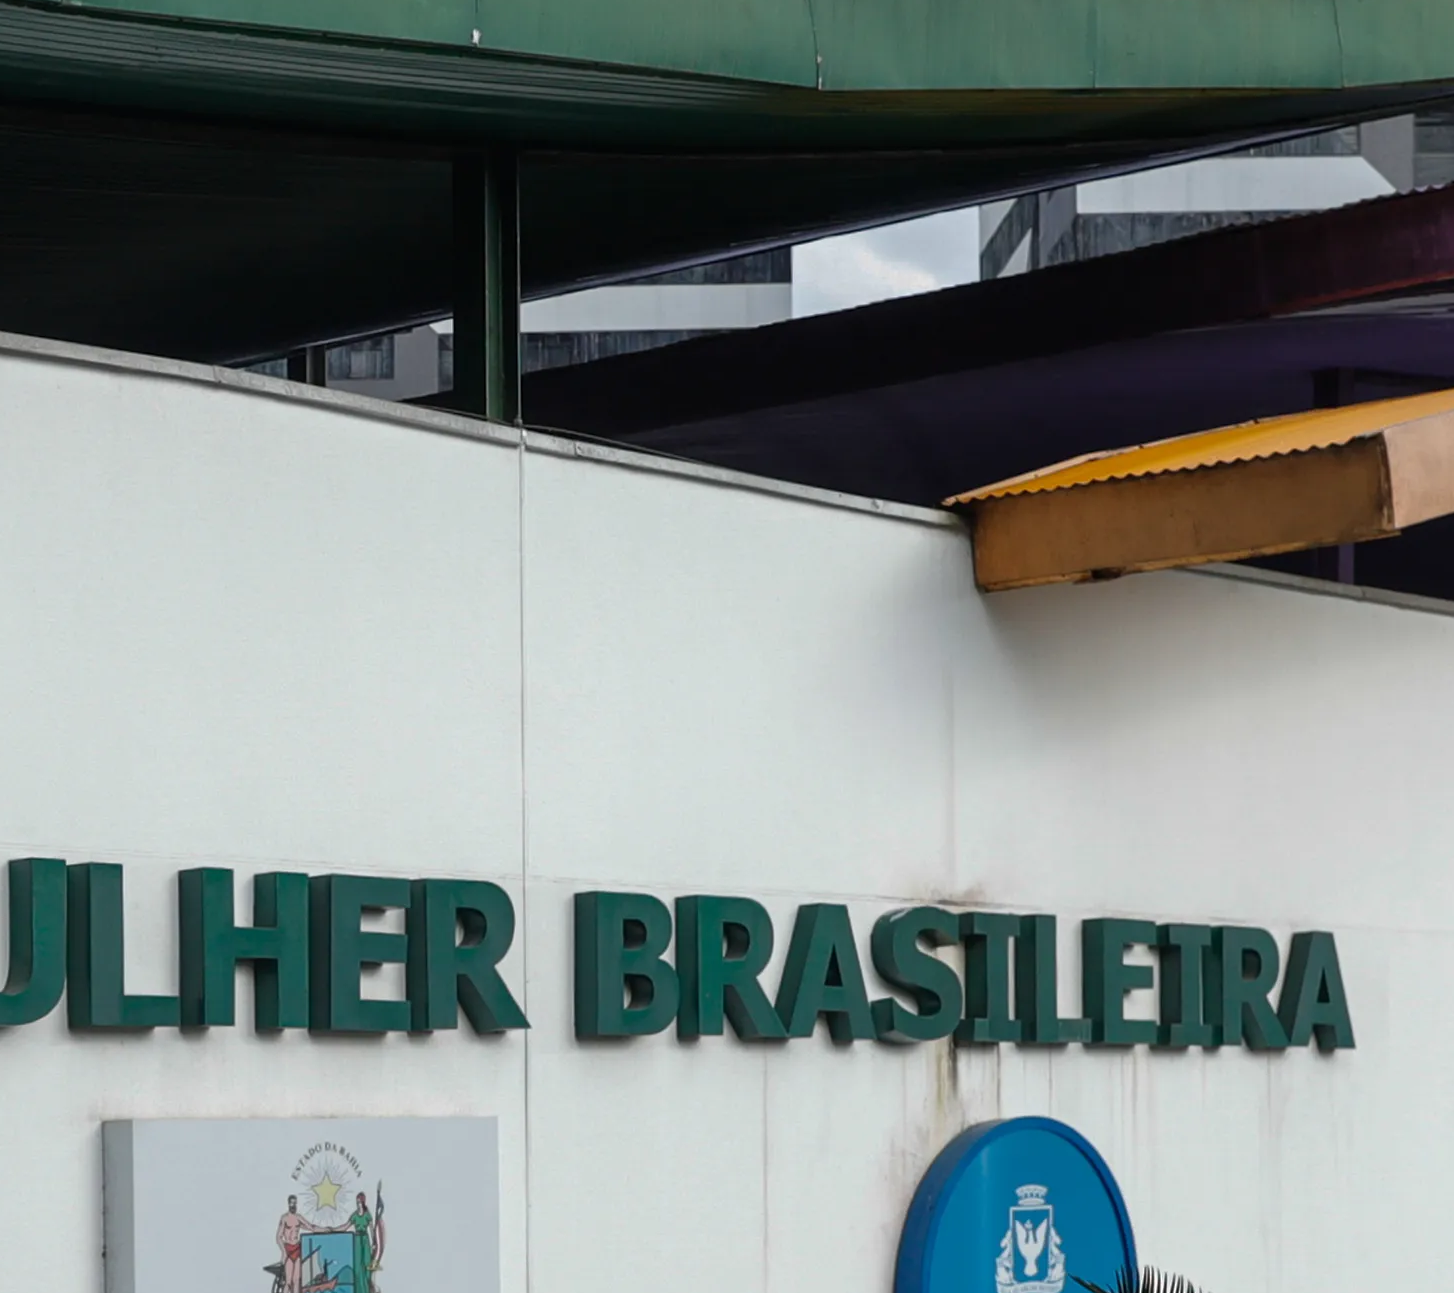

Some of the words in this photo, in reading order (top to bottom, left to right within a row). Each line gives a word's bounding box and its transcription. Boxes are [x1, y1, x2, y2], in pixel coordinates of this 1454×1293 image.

[574, 891, 1355, 1051] BRASILEIRA
[291, 1143, 322, 1182] ESTADO
[324, 1141, 338, 1153] DA
[338, 1146, 363, 1178] BAHIA
